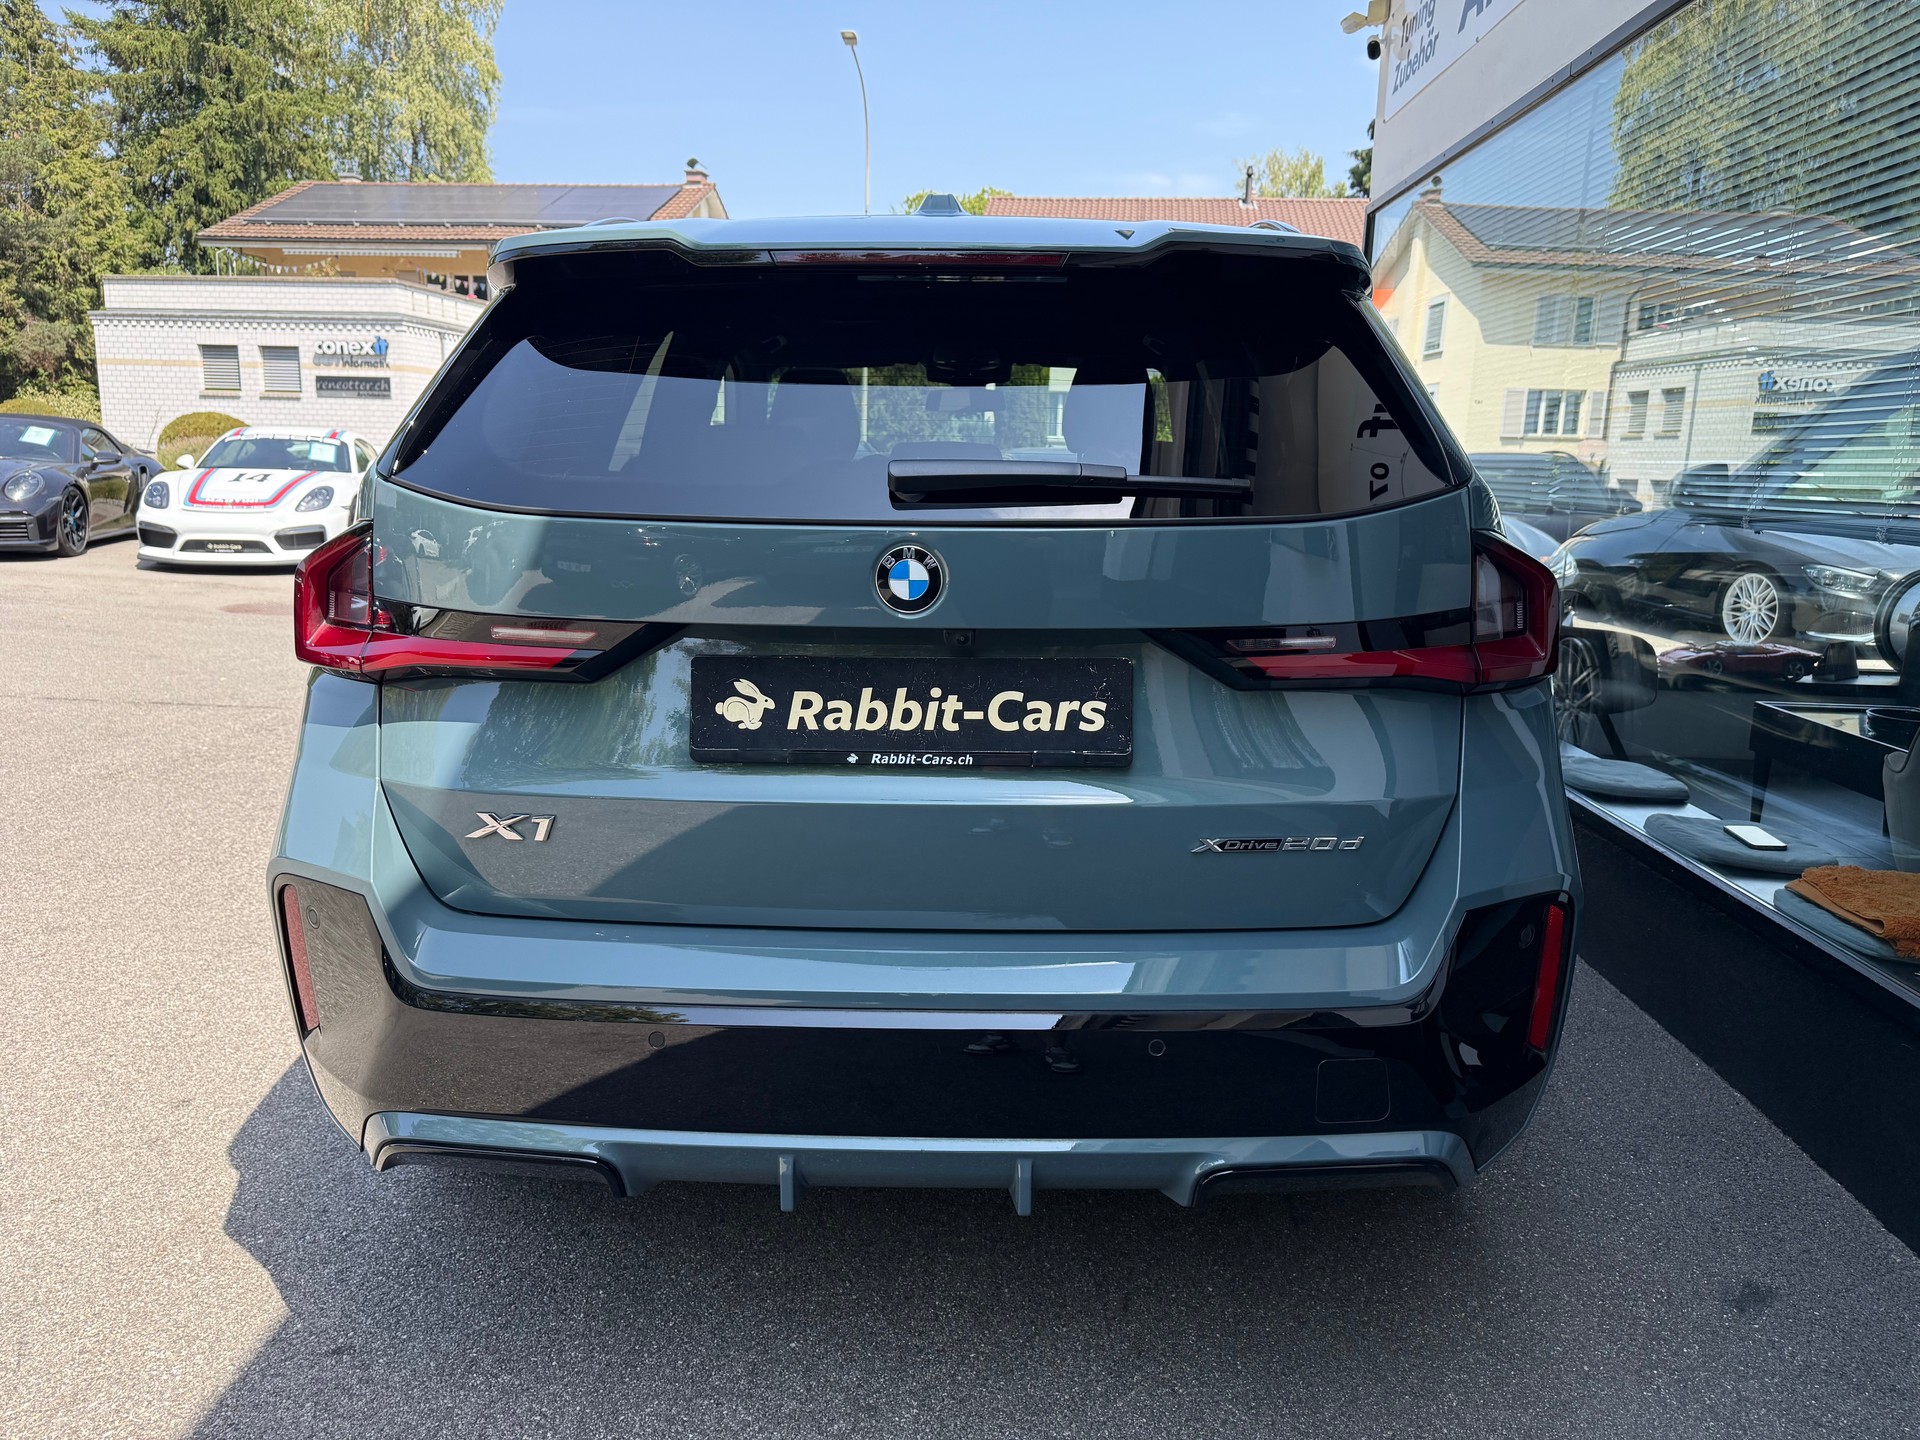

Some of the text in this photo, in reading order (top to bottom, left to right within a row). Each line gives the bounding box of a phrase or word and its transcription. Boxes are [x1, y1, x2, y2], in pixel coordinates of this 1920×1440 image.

[1401, 0, 1436, 48] Tuning
[1392, 26, 1440, 96] Zubehör
[228, 472, 272, 483] 14
[881, 547, 938, 570] BMW
[786, 686, 1108, 732] Rabbit-Cars
[871, 753, 974, 765] Rabbit-Cars.ch
[464, 811, 557, 841] X1
